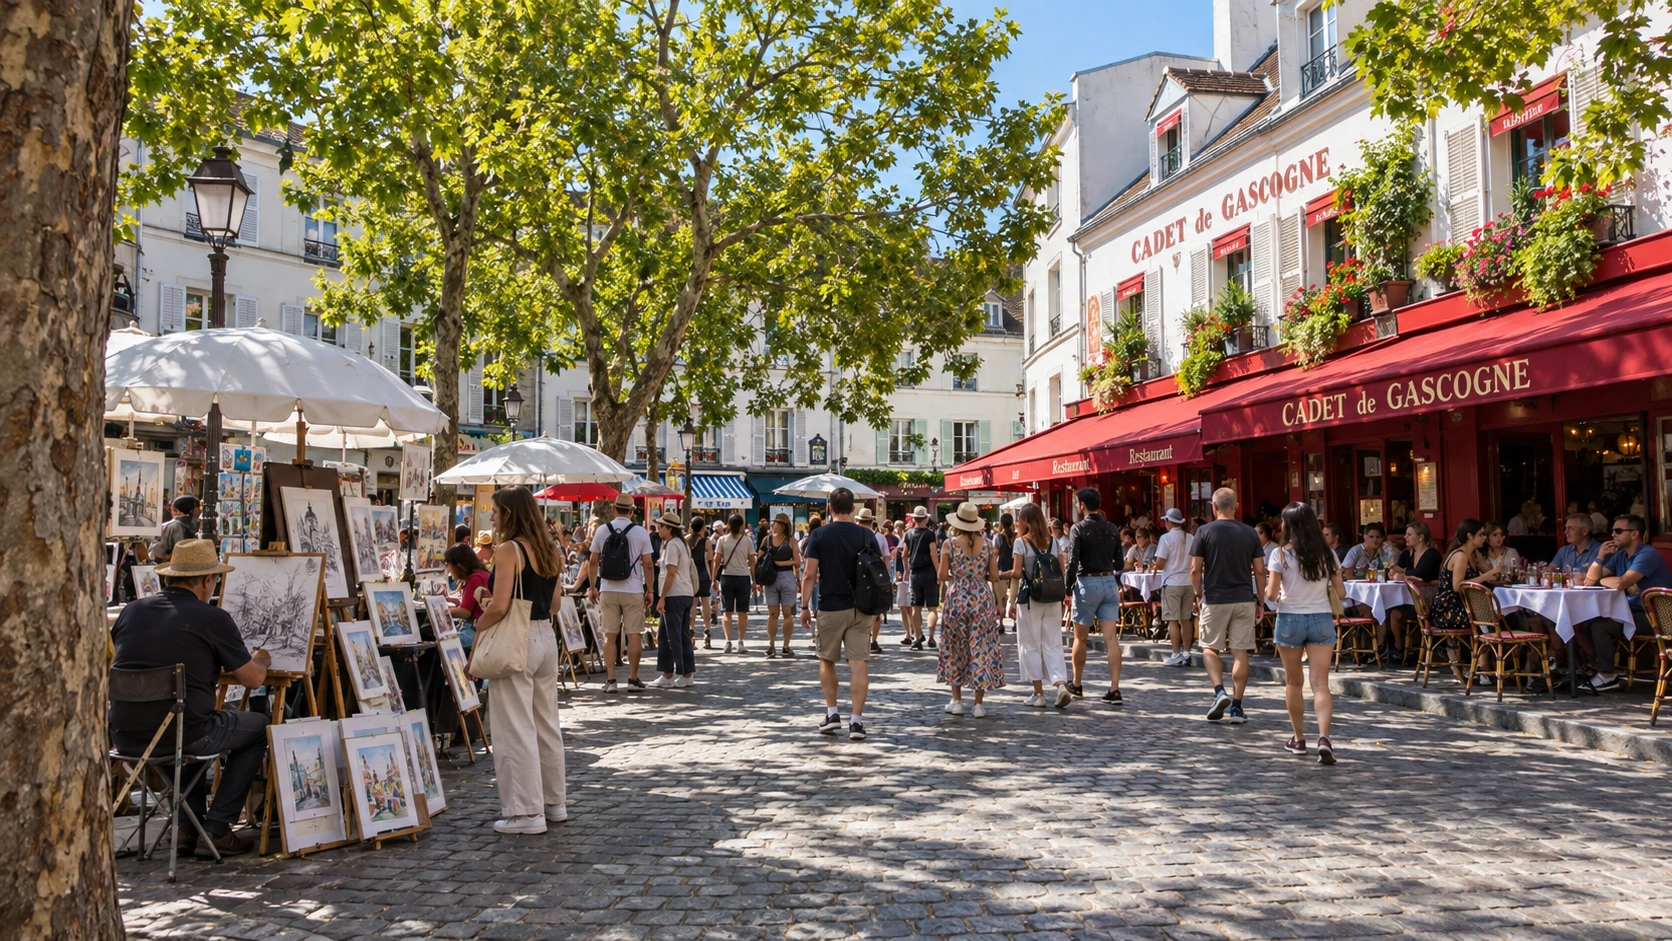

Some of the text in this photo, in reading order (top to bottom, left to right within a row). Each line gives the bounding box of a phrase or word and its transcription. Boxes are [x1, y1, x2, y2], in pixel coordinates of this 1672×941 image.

[1131, 147, 1331, 264] CADET de GASCOGNE
[1282, 358, 1531, 427] CADET de GASCOGNE
[1129, 444, 1173, 465] Restaurant
